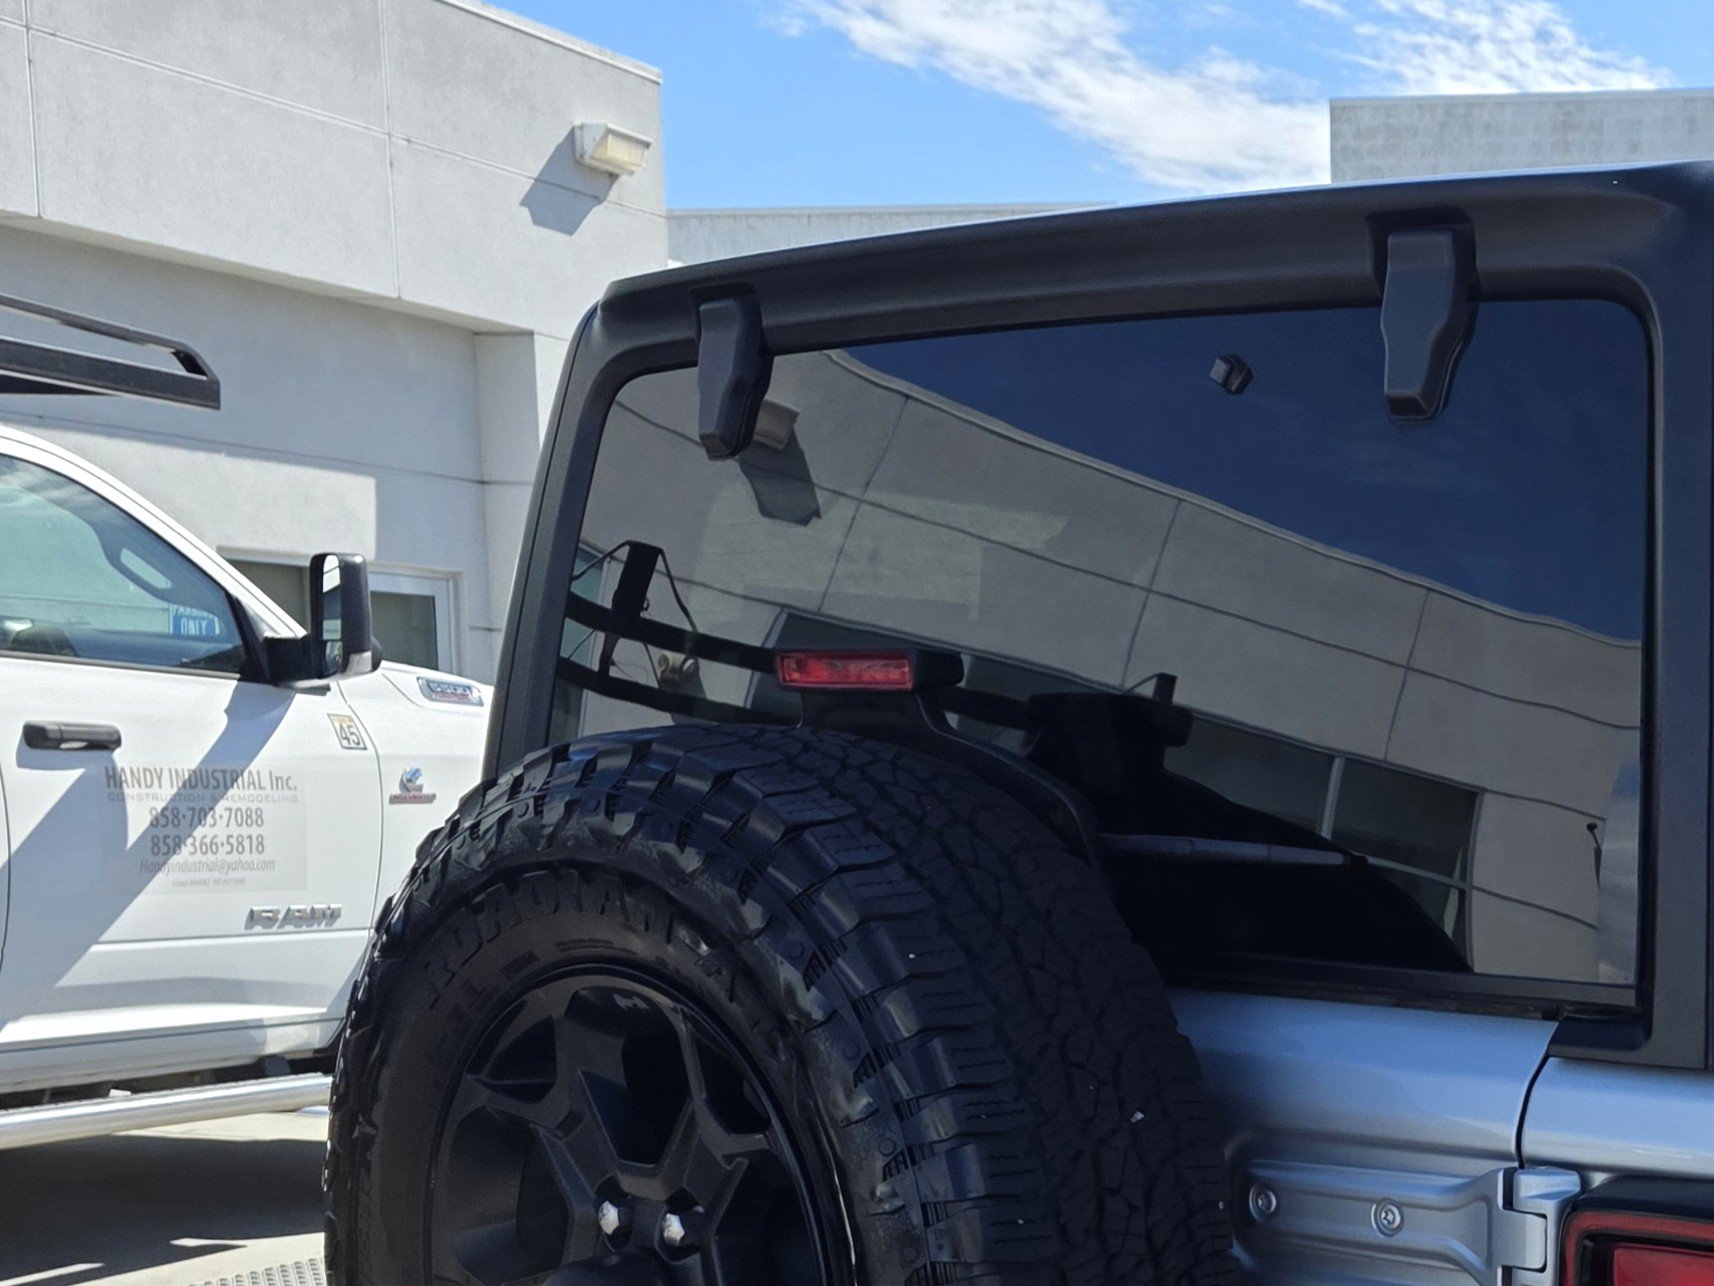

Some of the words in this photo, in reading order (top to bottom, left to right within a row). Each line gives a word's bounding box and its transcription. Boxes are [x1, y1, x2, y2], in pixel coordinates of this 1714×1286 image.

[104, 766, 164, 789] HANDY
[168, 766, 266, 791] INDUSTRIAL
[269, 770, 298, 791] Inc.
[108, 792, 205, 803] CONSTRUCTION
[223, 792, 298, 803] REMODELING
[247, 904, 342, 926] RAM
